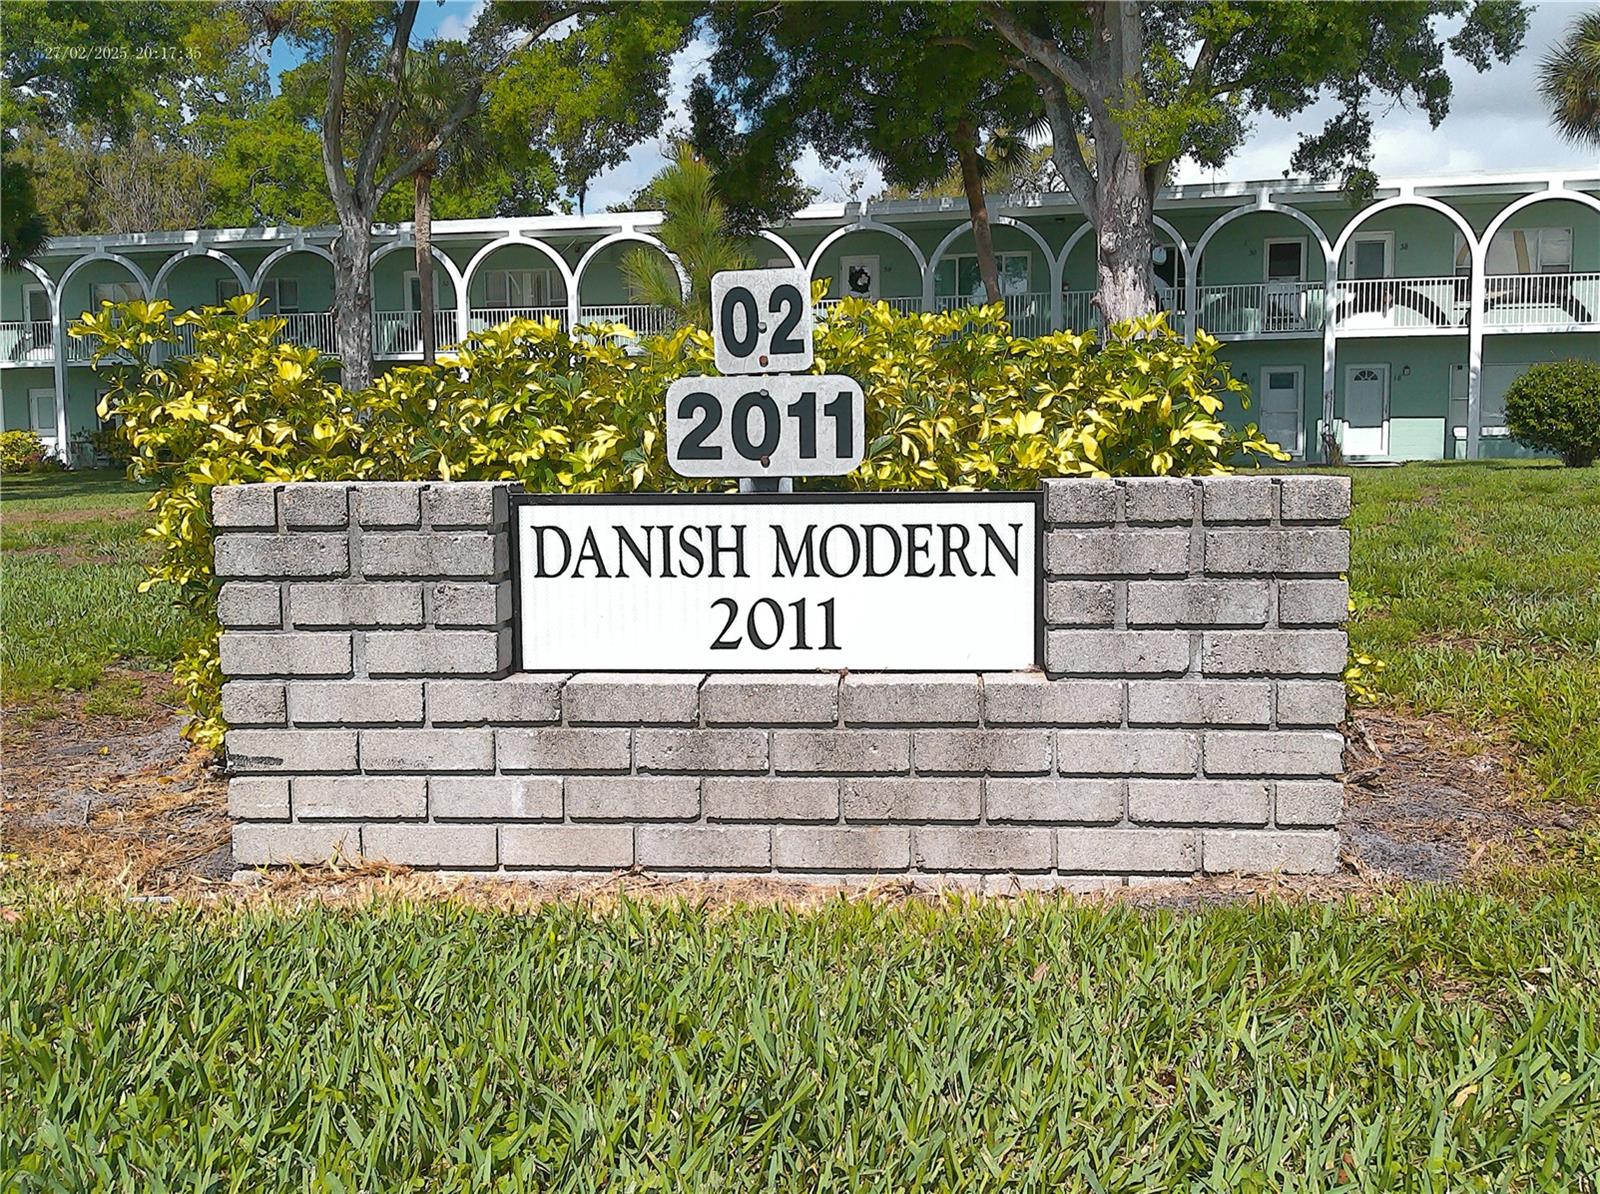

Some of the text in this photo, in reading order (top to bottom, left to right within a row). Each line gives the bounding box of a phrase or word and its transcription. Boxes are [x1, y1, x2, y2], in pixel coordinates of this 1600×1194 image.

[721, 284, 804, 358] 02
[677, 390, 853, 461] 2011
[531, 524, 1023, 578] DANISH MODERN
[710, 598, 842, 650] 2011
